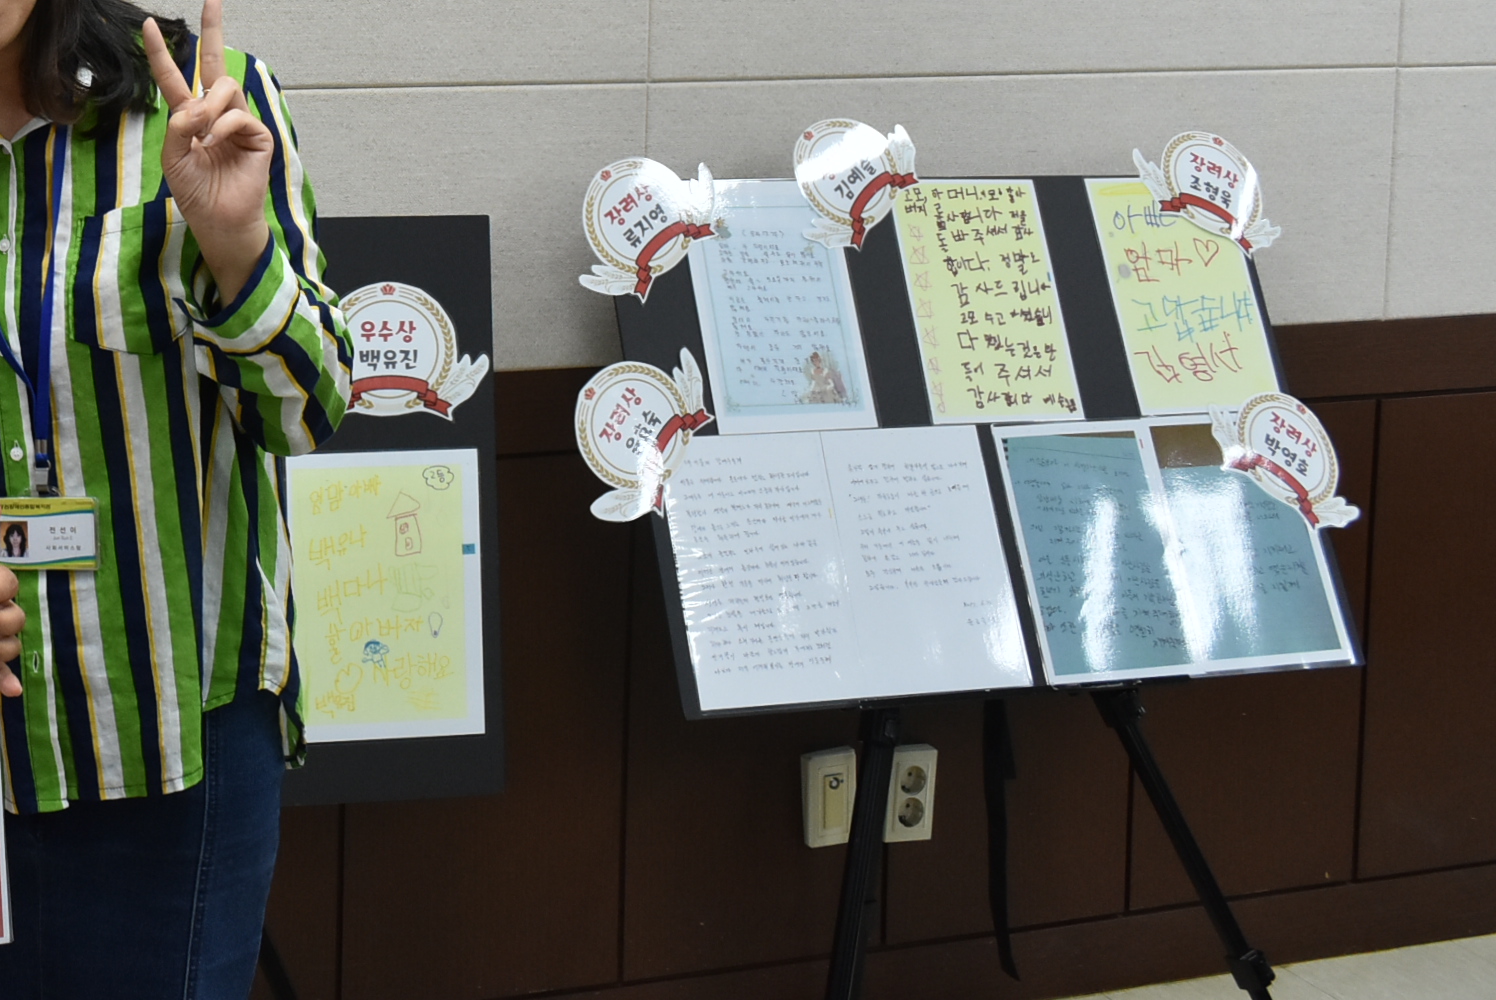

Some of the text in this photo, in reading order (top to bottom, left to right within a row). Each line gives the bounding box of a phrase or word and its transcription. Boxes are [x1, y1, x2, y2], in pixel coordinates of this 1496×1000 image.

[834, 159, 877, 200] 김예슬
[1189, 152, 1239, 189] 장려상
[604, 184, 652, 225] 장려상
[1189, 174, 1232, 209] 조형욱
[623, 203, 668, 248] 류지영
[360, 320, 417, 343] 우수상
[359, 349, 418, 371] 백유진
[1269, 411, 1317, 457] 장려상
[1264, 433, 1309, 477] 박영호
